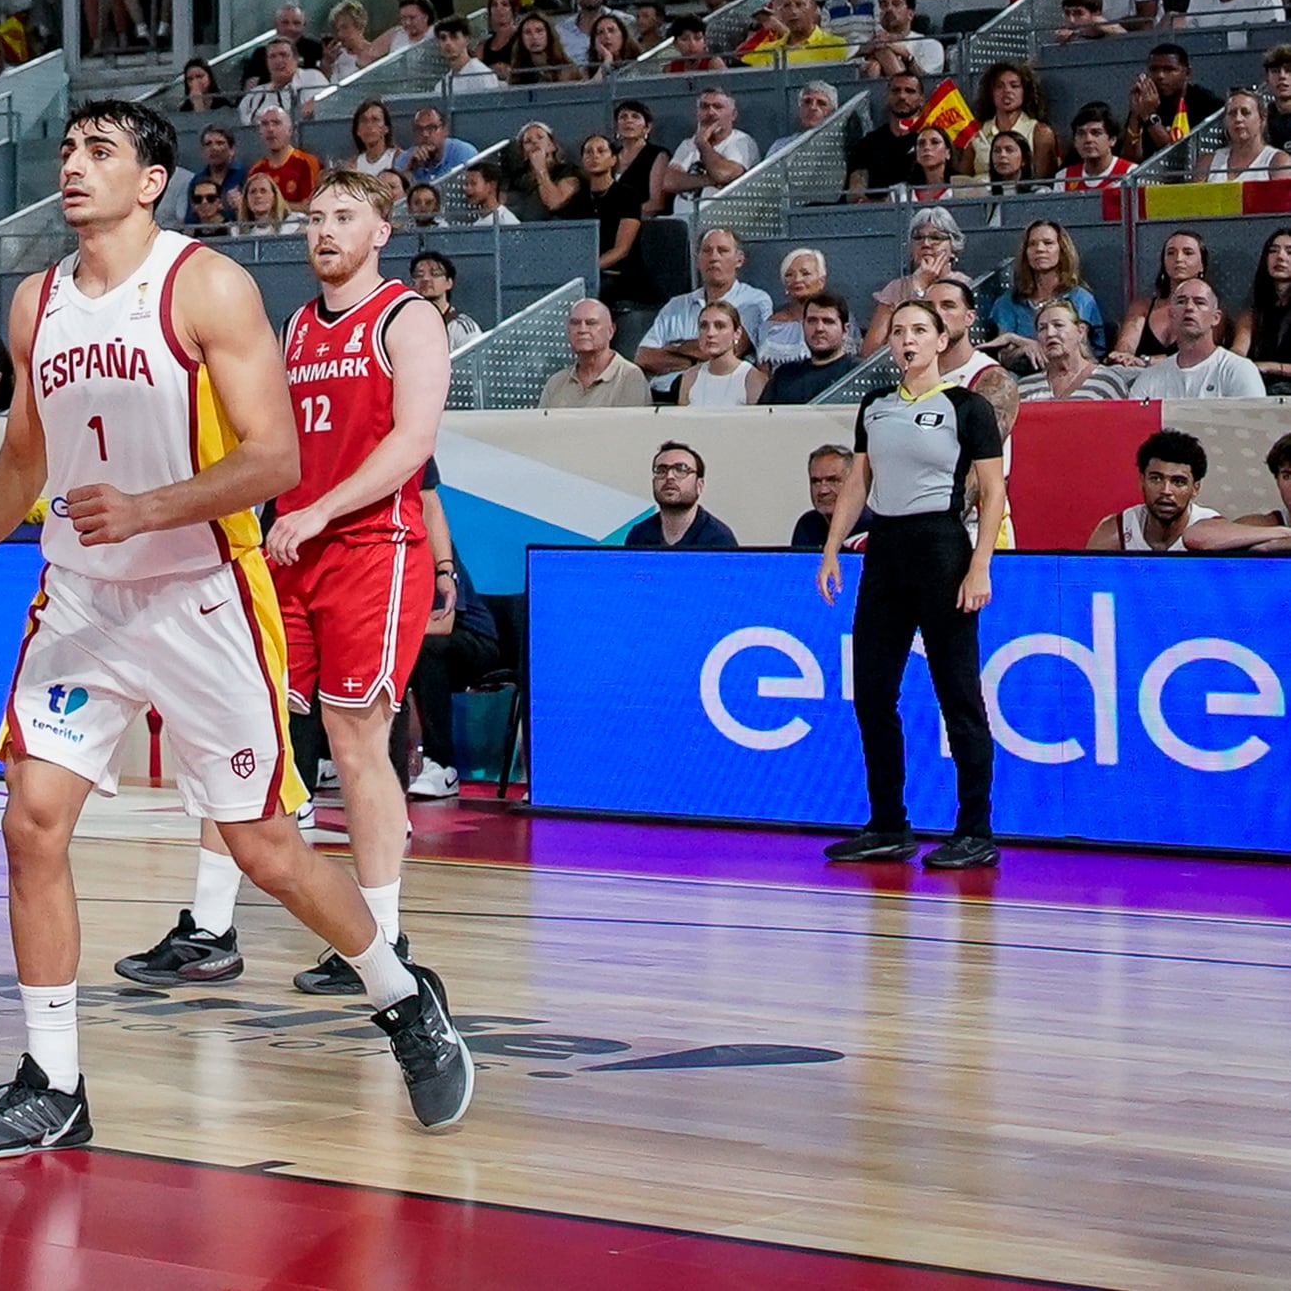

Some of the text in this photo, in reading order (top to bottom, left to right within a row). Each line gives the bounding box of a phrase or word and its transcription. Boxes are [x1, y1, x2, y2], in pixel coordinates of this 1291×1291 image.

[39, 337, 155, 398] ESPAÑA
[286, 357, 371, 386] ANMARK
[301, 395, 333, 433] 12
[87, 415, 108, 461] 1
